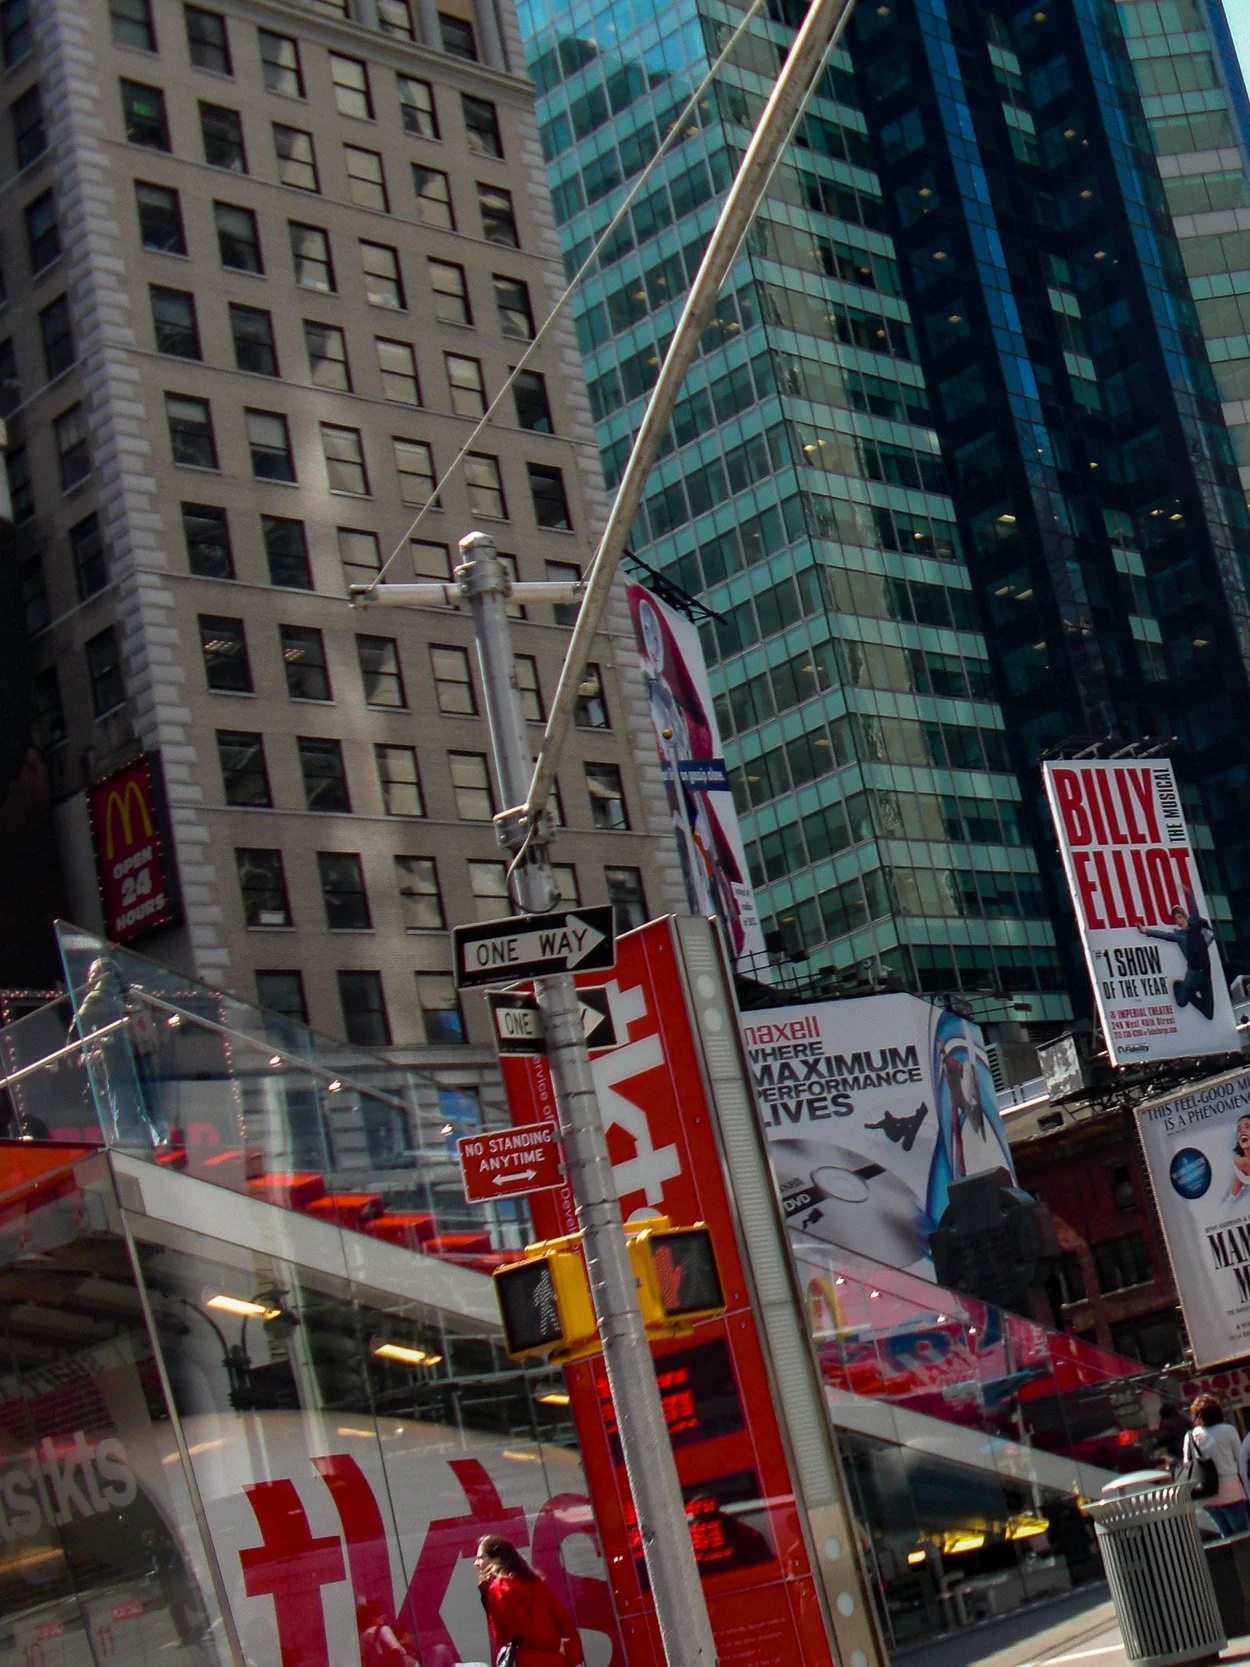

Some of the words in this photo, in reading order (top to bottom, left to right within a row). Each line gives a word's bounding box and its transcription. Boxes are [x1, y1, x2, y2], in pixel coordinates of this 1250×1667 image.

[1052, 768, 1162, 846] BILLY
[1153, 767, 1179, 818] MUSICAL
[1169, 824, 1187, 843] THE
[113, 846, 153, 879] OPEN
[121, 867, 153, 907] 24
[1073, 847, 1194, 930] ELLIOT
[116, 893, 165, 932] HOURS
[477, 939, 519, 967] ONE
[539, 928, 589, 956] WAY
[1114, 946, 1162, 977] SHOW
[1103, 981, 1116, 999] OF
[1119, 979, 1139, 998] THE
[505, 1011, 532, 1036] ONE
[749, 1041, 824, 1064] WHERE
[752, 1045, 920, 1088] MAXIMUM
[532, 1057, 549, 1102] ervice
[759, 1067, 923, 1102] ERFORMANCE
[1175, 1083, 1234, 1112] FEEL-GOOD
[1164, 1118, 1175, 1131] IS
[1178, 1115, 1187, 1126] A
[465, 1143, 483, 1158] NO
[489, 1129, 551, 1151] STANDING
[479, 1150, 545, 1172] ANYTIME
[785, 1193, 811, 1212] DVD
